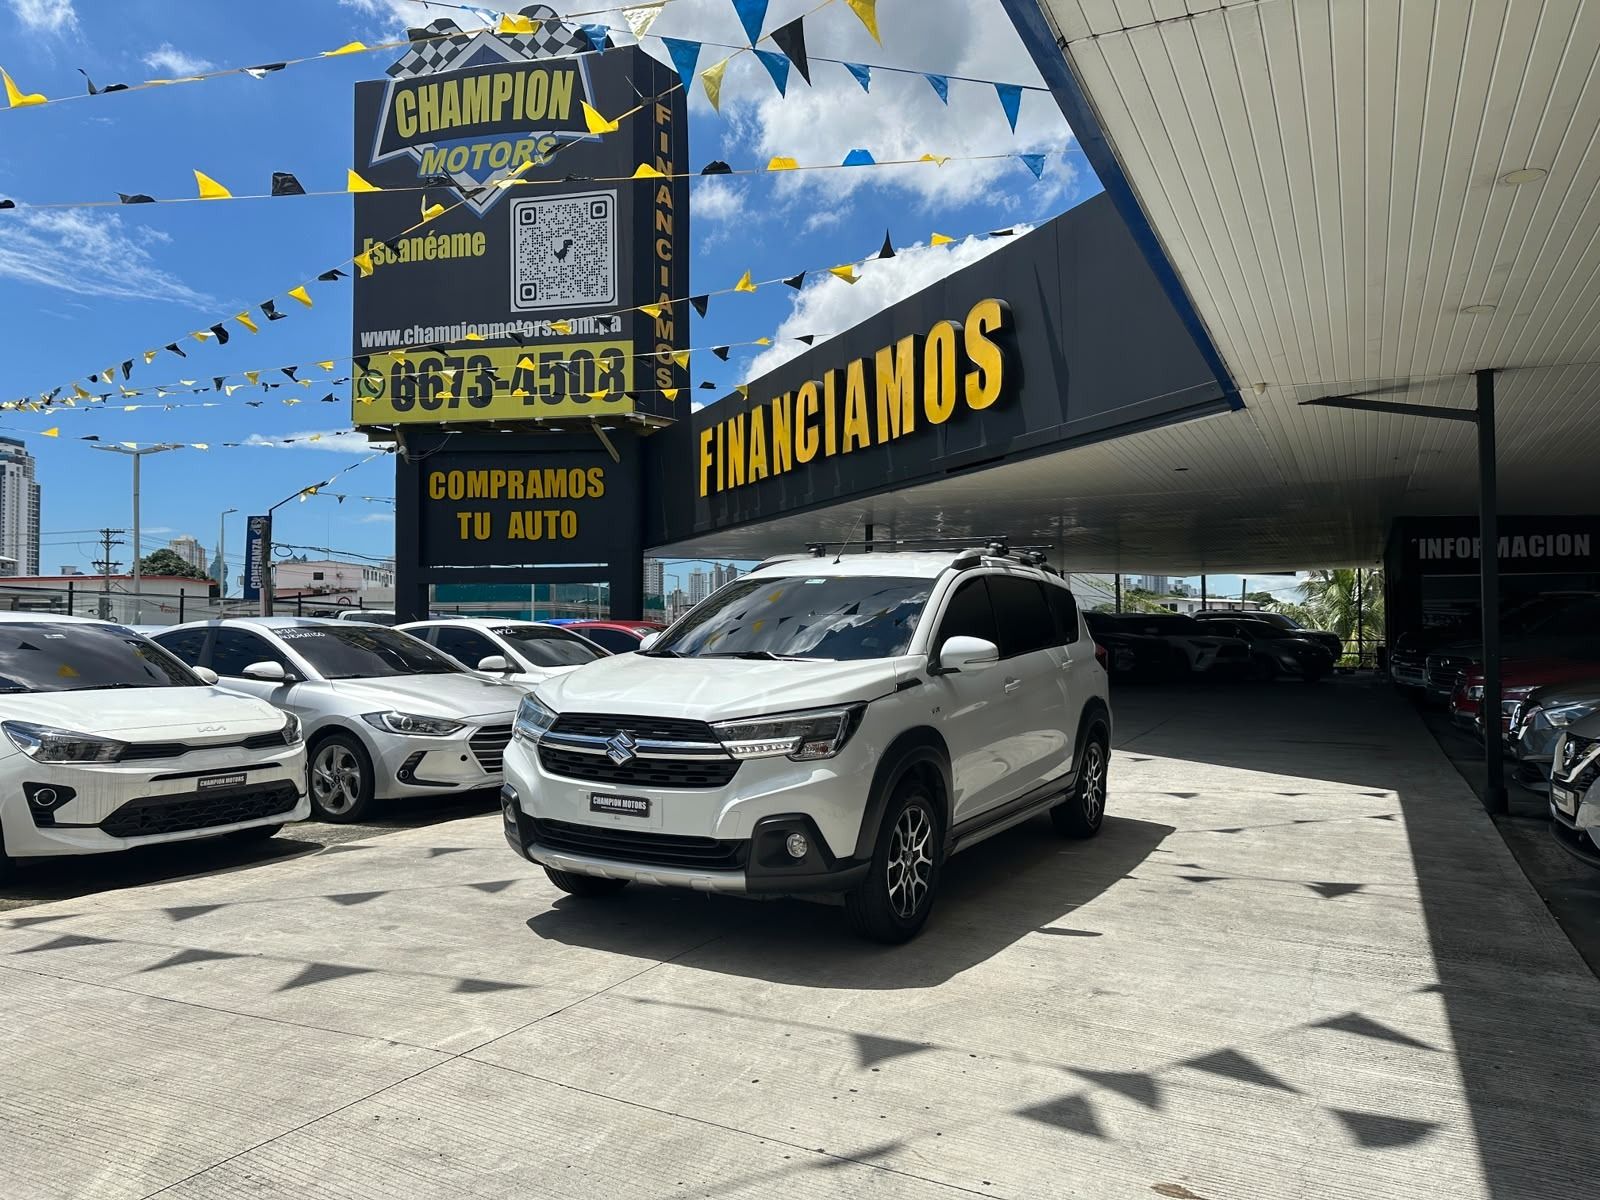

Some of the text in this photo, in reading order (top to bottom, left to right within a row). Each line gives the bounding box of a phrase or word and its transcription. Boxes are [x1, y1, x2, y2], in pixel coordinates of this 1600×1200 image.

[395, 69, 575, 138] CHAMPION
[420, 136, 557, 175] MOTORS
[655, 103, 673, 389] FINANCIAMOS
[391, 347, 625, 412] 6673-4508
[700, 298, 1004, 498] FINANCIAMOS
[429, 467, 605, 500] COMPRAMOS
[457, 510, 578, 540] TU AUTO
[250, 538, 264, 589] CONFIANZA
[593, 796, 622, 807] CHAMPION
[622, 799, 647, 810] MOTORS
